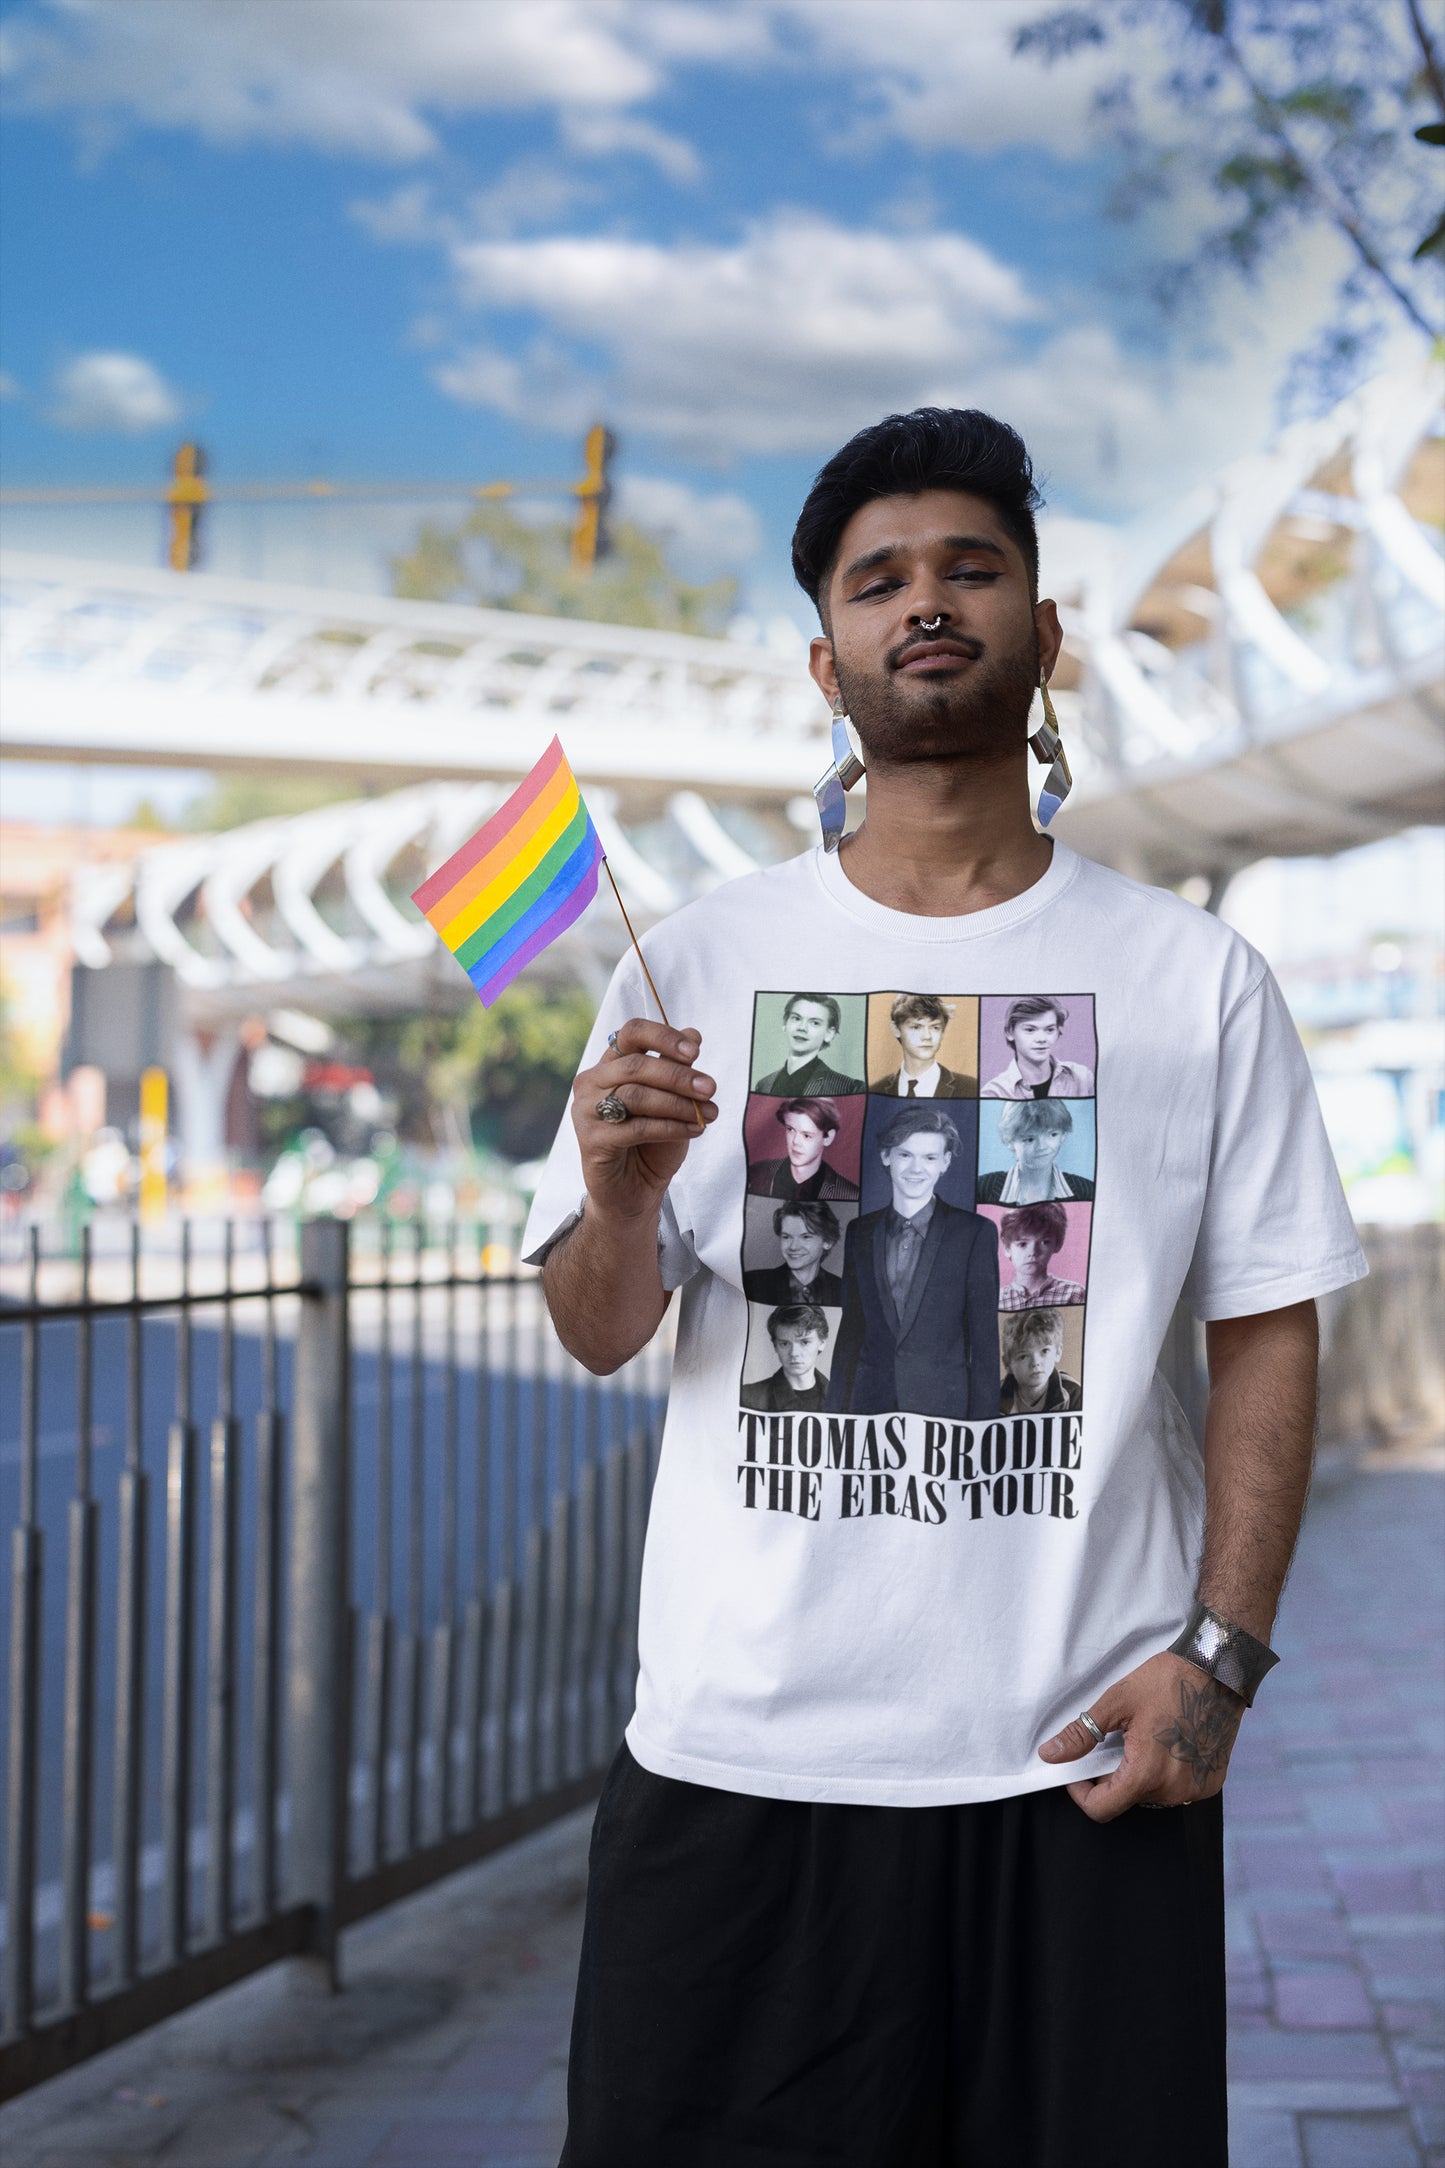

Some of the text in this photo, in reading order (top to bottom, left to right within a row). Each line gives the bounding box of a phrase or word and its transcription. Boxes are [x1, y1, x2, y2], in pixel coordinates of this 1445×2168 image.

[738, 1411, 1083, 1481] THOMAS BRODIE
[737, 1465, 1079, 1525] THE ERAS TOUR
